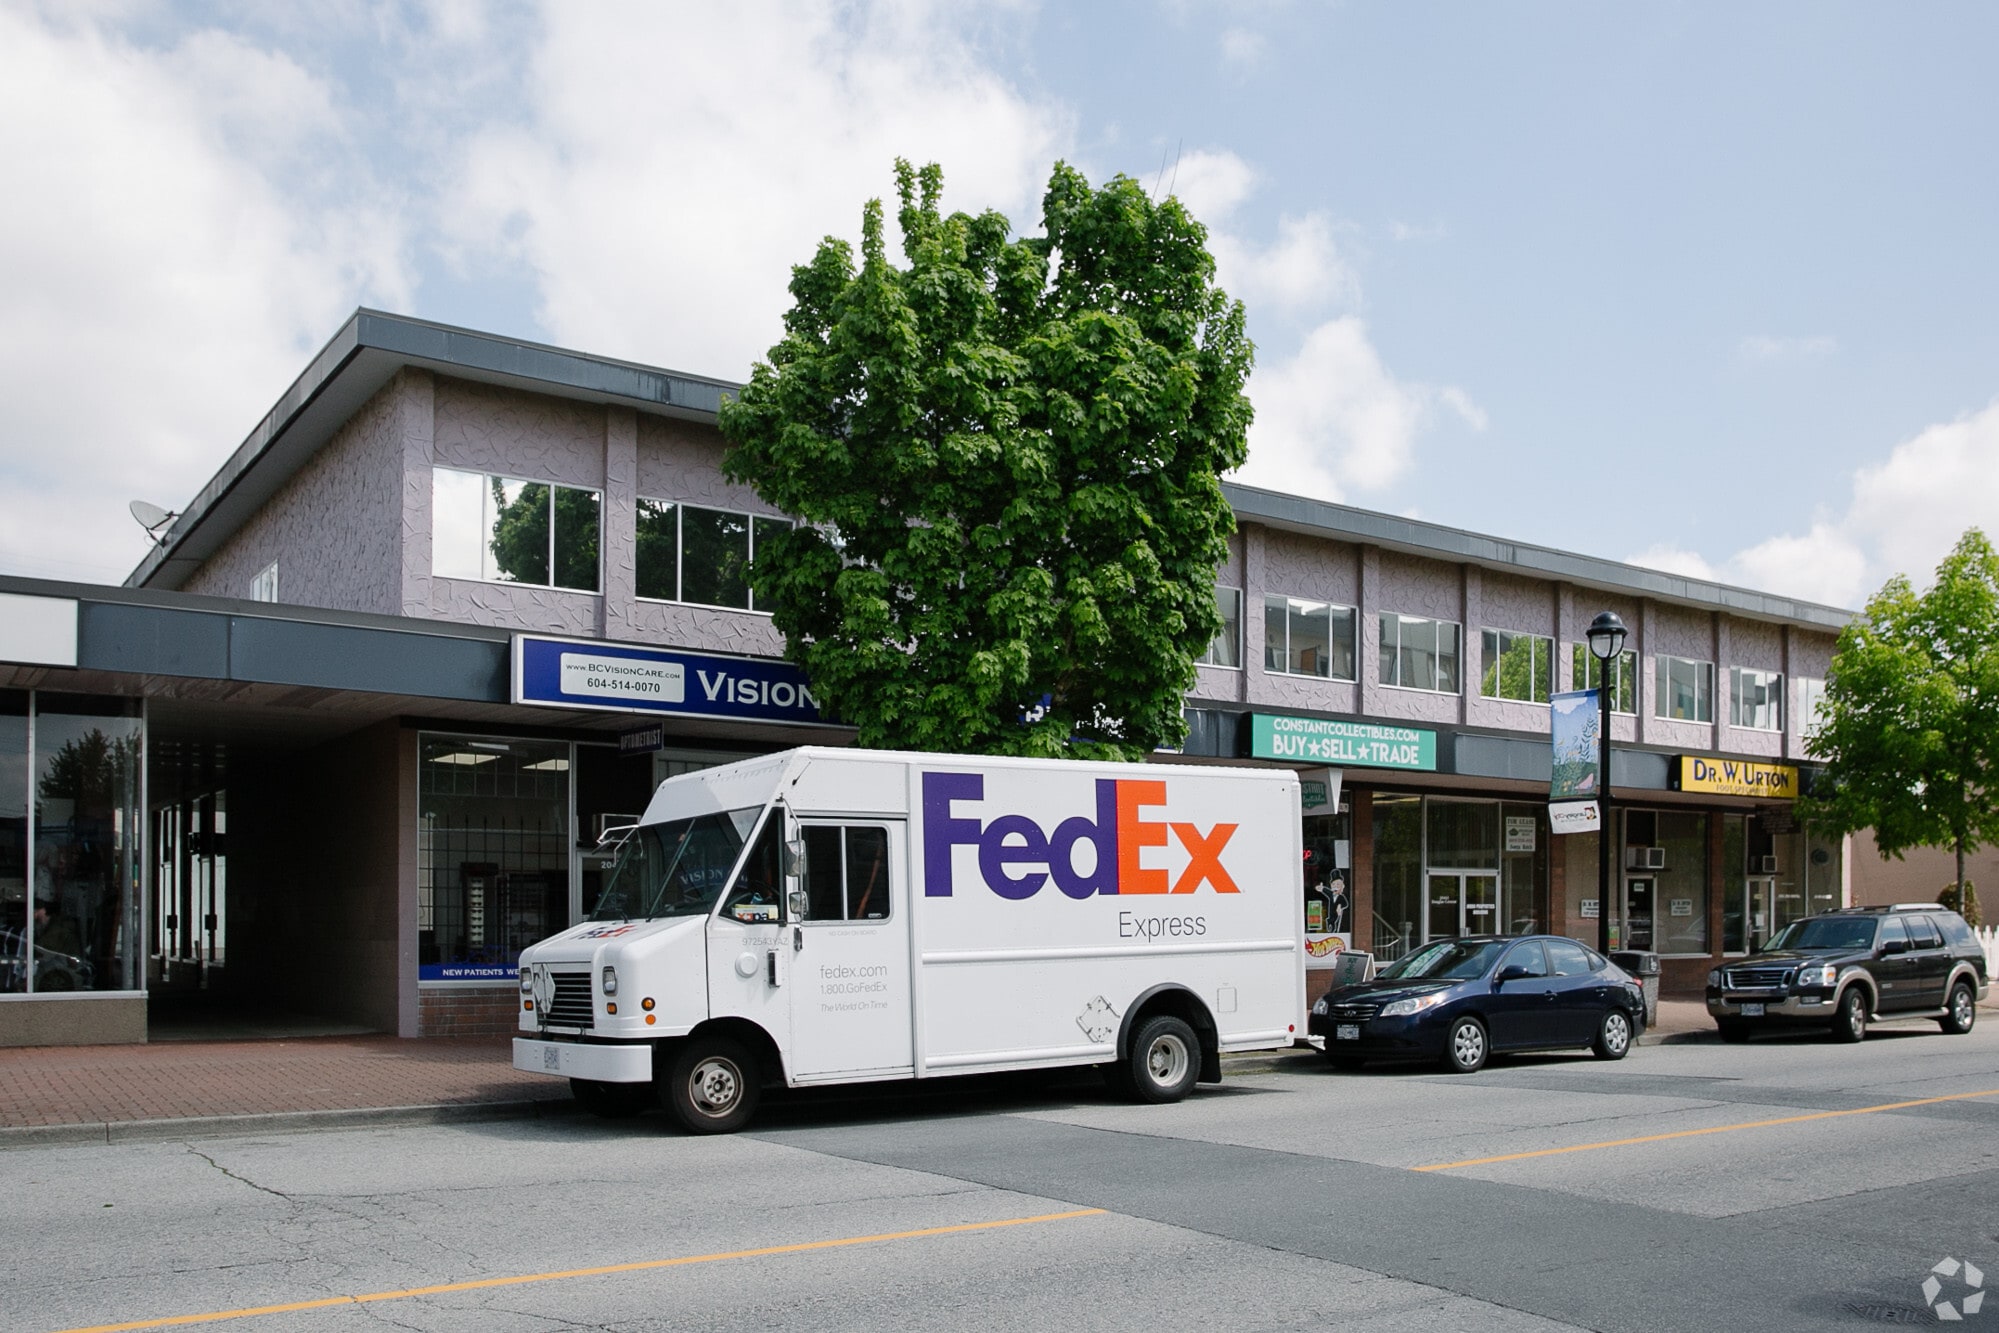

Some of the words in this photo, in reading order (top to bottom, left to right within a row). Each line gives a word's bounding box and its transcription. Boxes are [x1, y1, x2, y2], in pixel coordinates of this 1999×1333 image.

[587, 678, 660, 693] 604-514-0070
[696, 669, 820, 709] VISION
[1273, 717, 1419, 742] CONSTANTCOLLECTIBLES.COM
[1273, 734, 1307, 756] BUY
[1321, 738, 1357, 760] SELL
[1370, 742, 1419, 765] TRADE
[1744, 763, 1788, 788] URTON
[922, 771, 1242, 900] FedEx
[1119, 911, 1207, 943] Express
[442, 968, 463, 976] NEW
[464, 968, 503, 976] PATIENTS
[820, 964, 888, 979] fedex.com
[820, 981, 888, 995] 1.800.GoFedEx
[821, 1003, 834, 1012] The
[834, 1002, 857, 1011] World
[858, 1001, 870, 1010] On
[870, 1000, 888, 1009] Time
